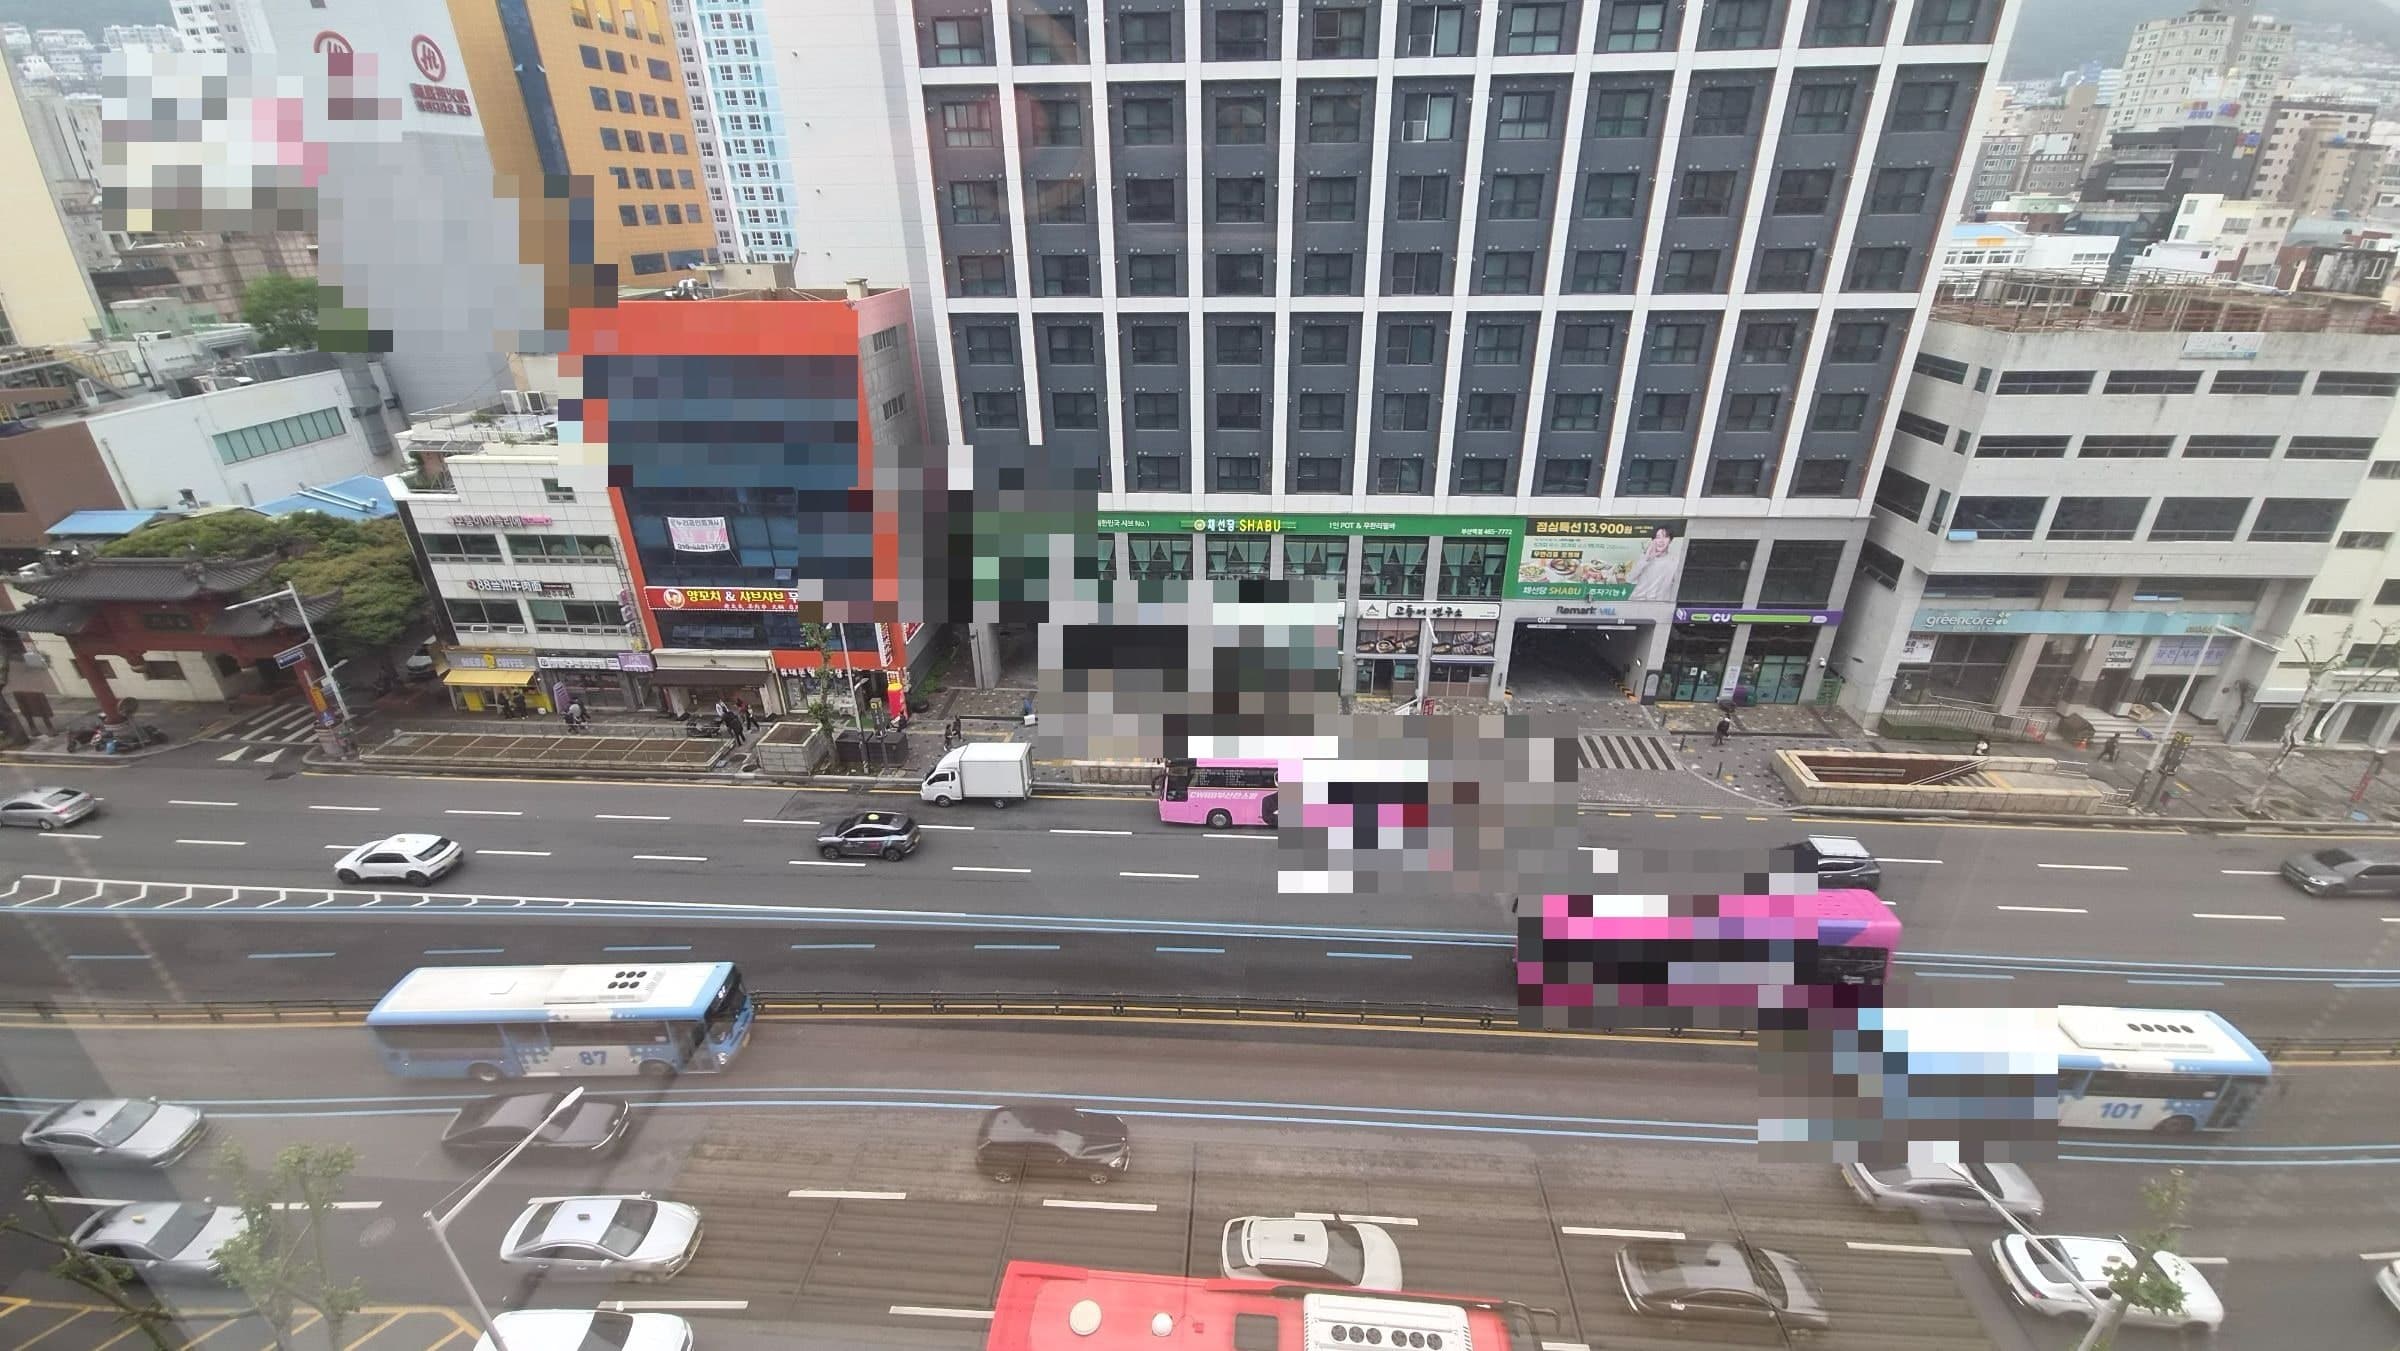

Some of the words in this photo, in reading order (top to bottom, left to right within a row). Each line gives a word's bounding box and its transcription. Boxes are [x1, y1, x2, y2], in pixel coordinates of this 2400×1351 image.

[1207, 519, 1235, 532] 채선당
[1239, 519, 1281, 532] SHABU
[1536, 521, 1581, 533] 점심특선
[725, 591, 737, 602] &
[740, 590, 786, 603] 샤브샤브
[1548, 585, 1582, 595] SHABU
[1394, 604, 1427, 617] 고등어
[1432, 606, 1463, 617] 연구소
[1712, 613, 1731, 623] CU
[579, 1050, 608, 1066] 87
[2100, 1102, 2143, 1120] 101
